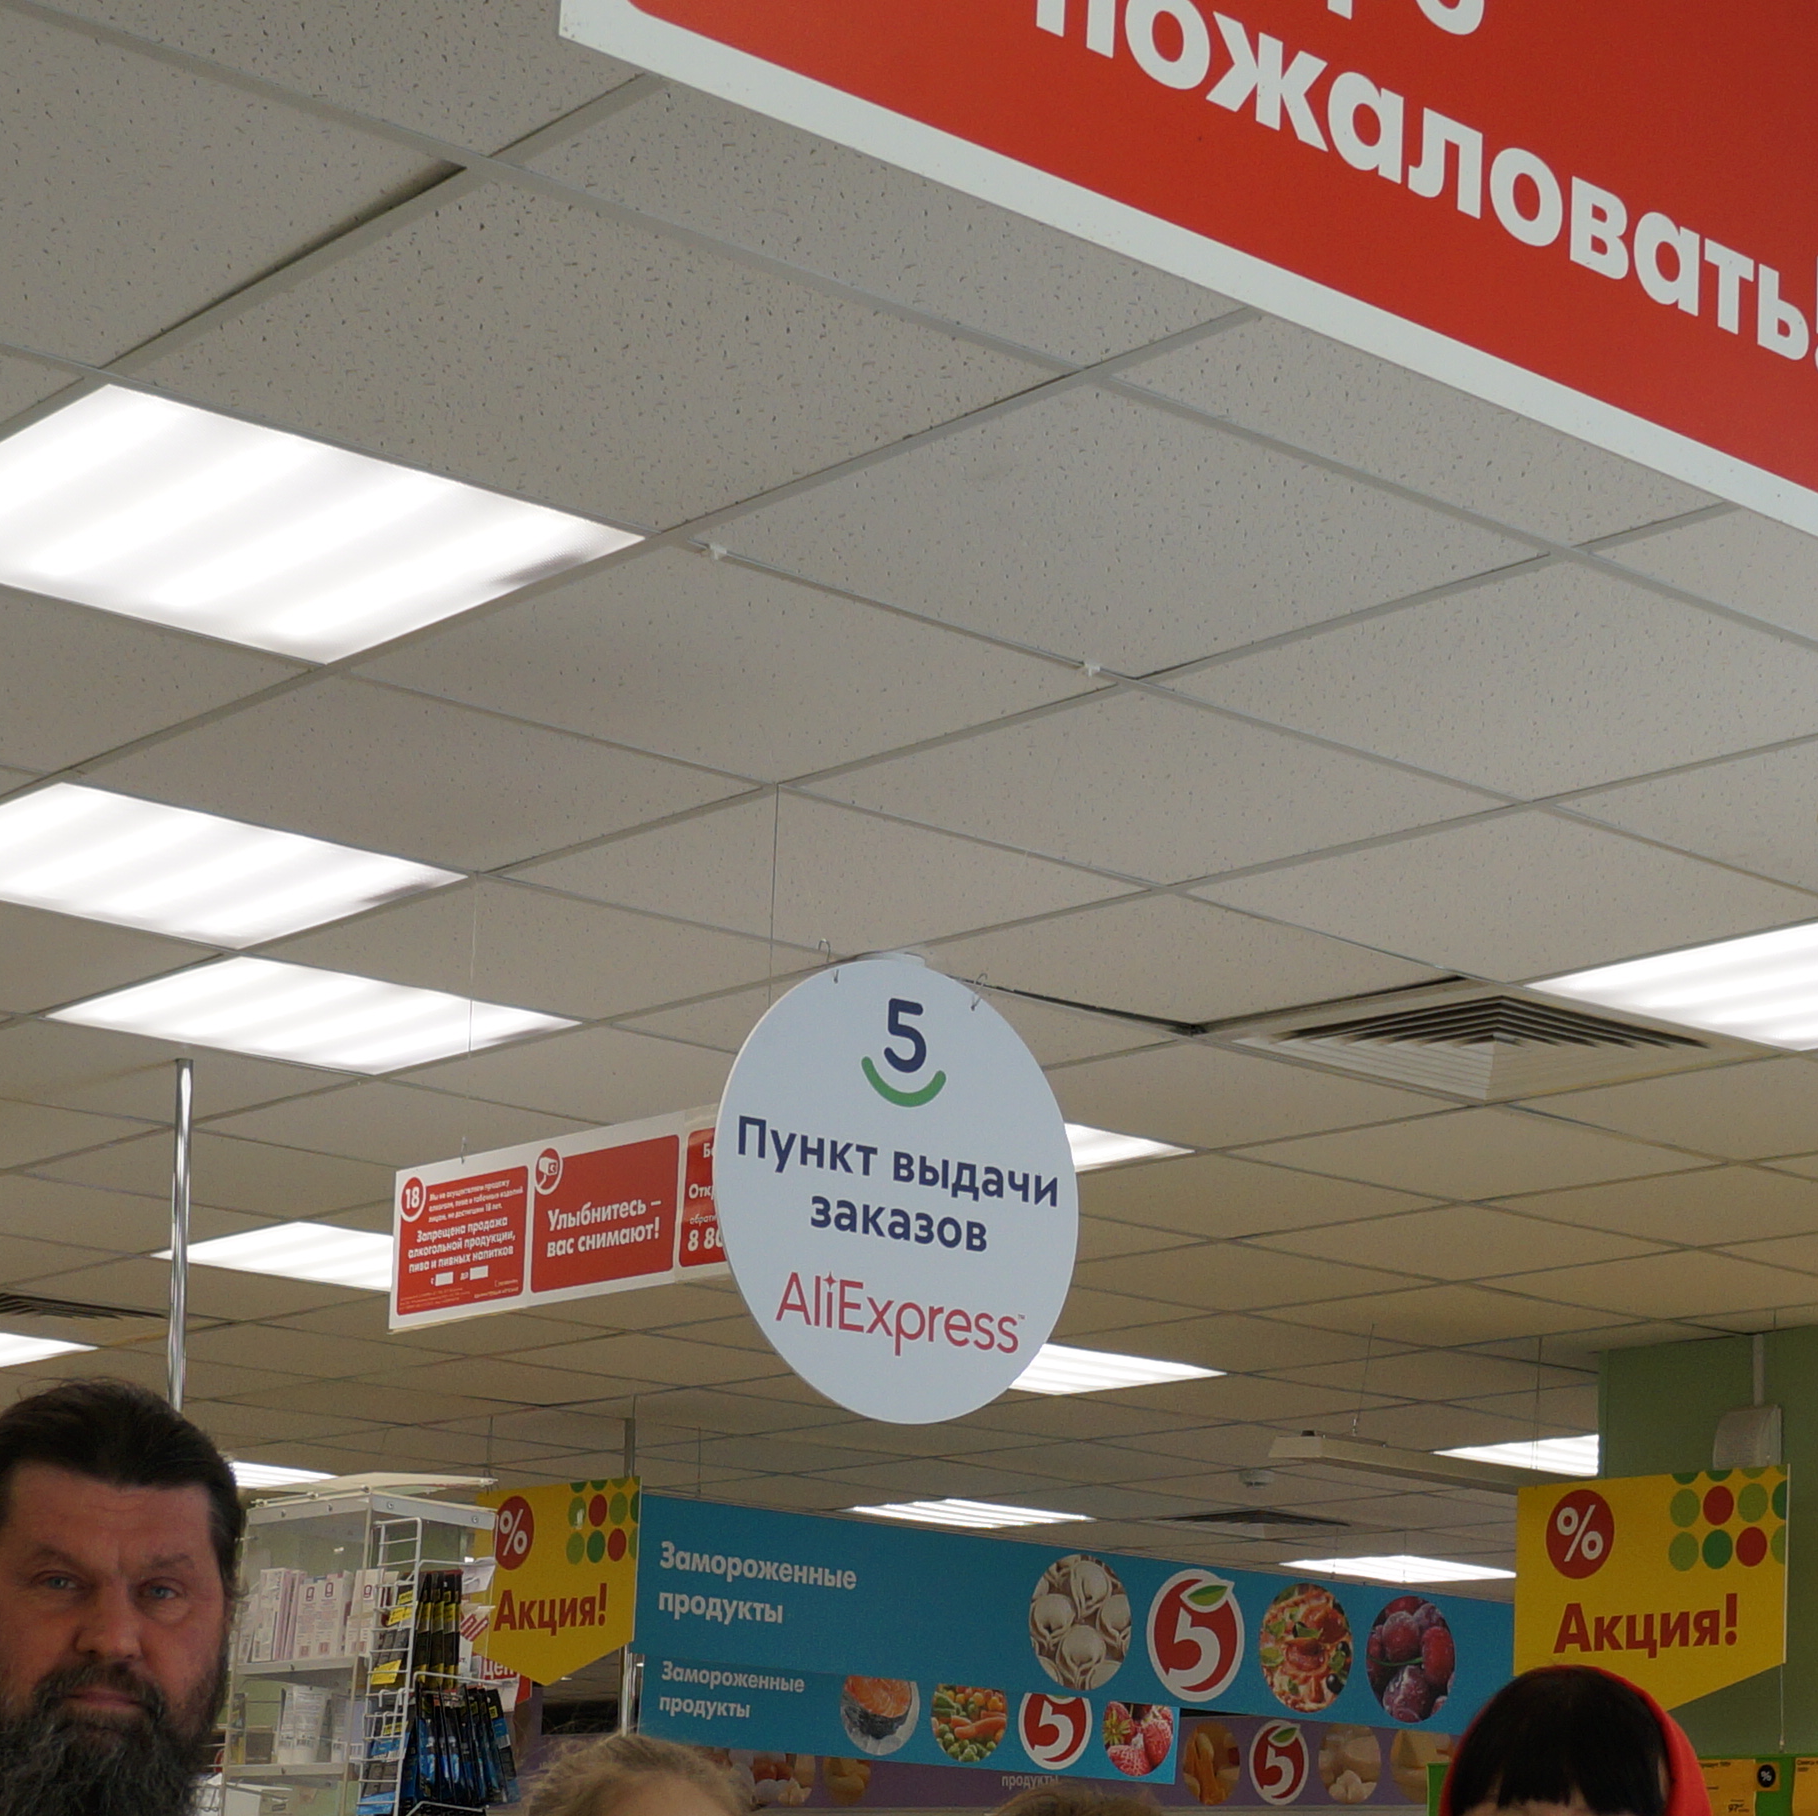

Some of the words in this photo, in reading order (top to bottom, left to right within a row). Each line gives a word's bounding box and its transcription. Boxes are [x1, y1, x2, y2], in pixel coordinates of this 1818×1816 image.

[883, 998, 927, 1074] 5
[737, 1115, 878, 1178] Пункт
[892, 1150, 1060, 1208] выдачи
[404, 1186, 420, 1209] 18
[416, 1224, 466, 1243] Запрещена
[467, 1216, 508, 1235] продажа
[547, 1199, 647, 1232] Улыбнитесь
[809, 1195, 988, 1253] заказов
[407, 1237, 463, 1259] алкогольной
[464, 1230, 516, 1250] продукции,
[547, 1238, 576, 1258] вас
[577, 1217, 661, 1253] снимают!
[688, 1229, 699, 1252] 8
[408, 1261, 430, 1273] пива
[438, 1254, 471, 1268] пивных
[472, 1246, 514, 1261] напитков
[775, 1270, 1021, 1357] AliExpress
[659, 1540, 857, 1591] Замороженные
[493, 1583, 608, 1638] Акция!
[658, 1590, 784, 1625] продукты
[1553, 1593, 1739, 1659] Акция!
[661, 1660, 806, 1694] Замороженные
[658, 1694, 751, 1719] продукты
